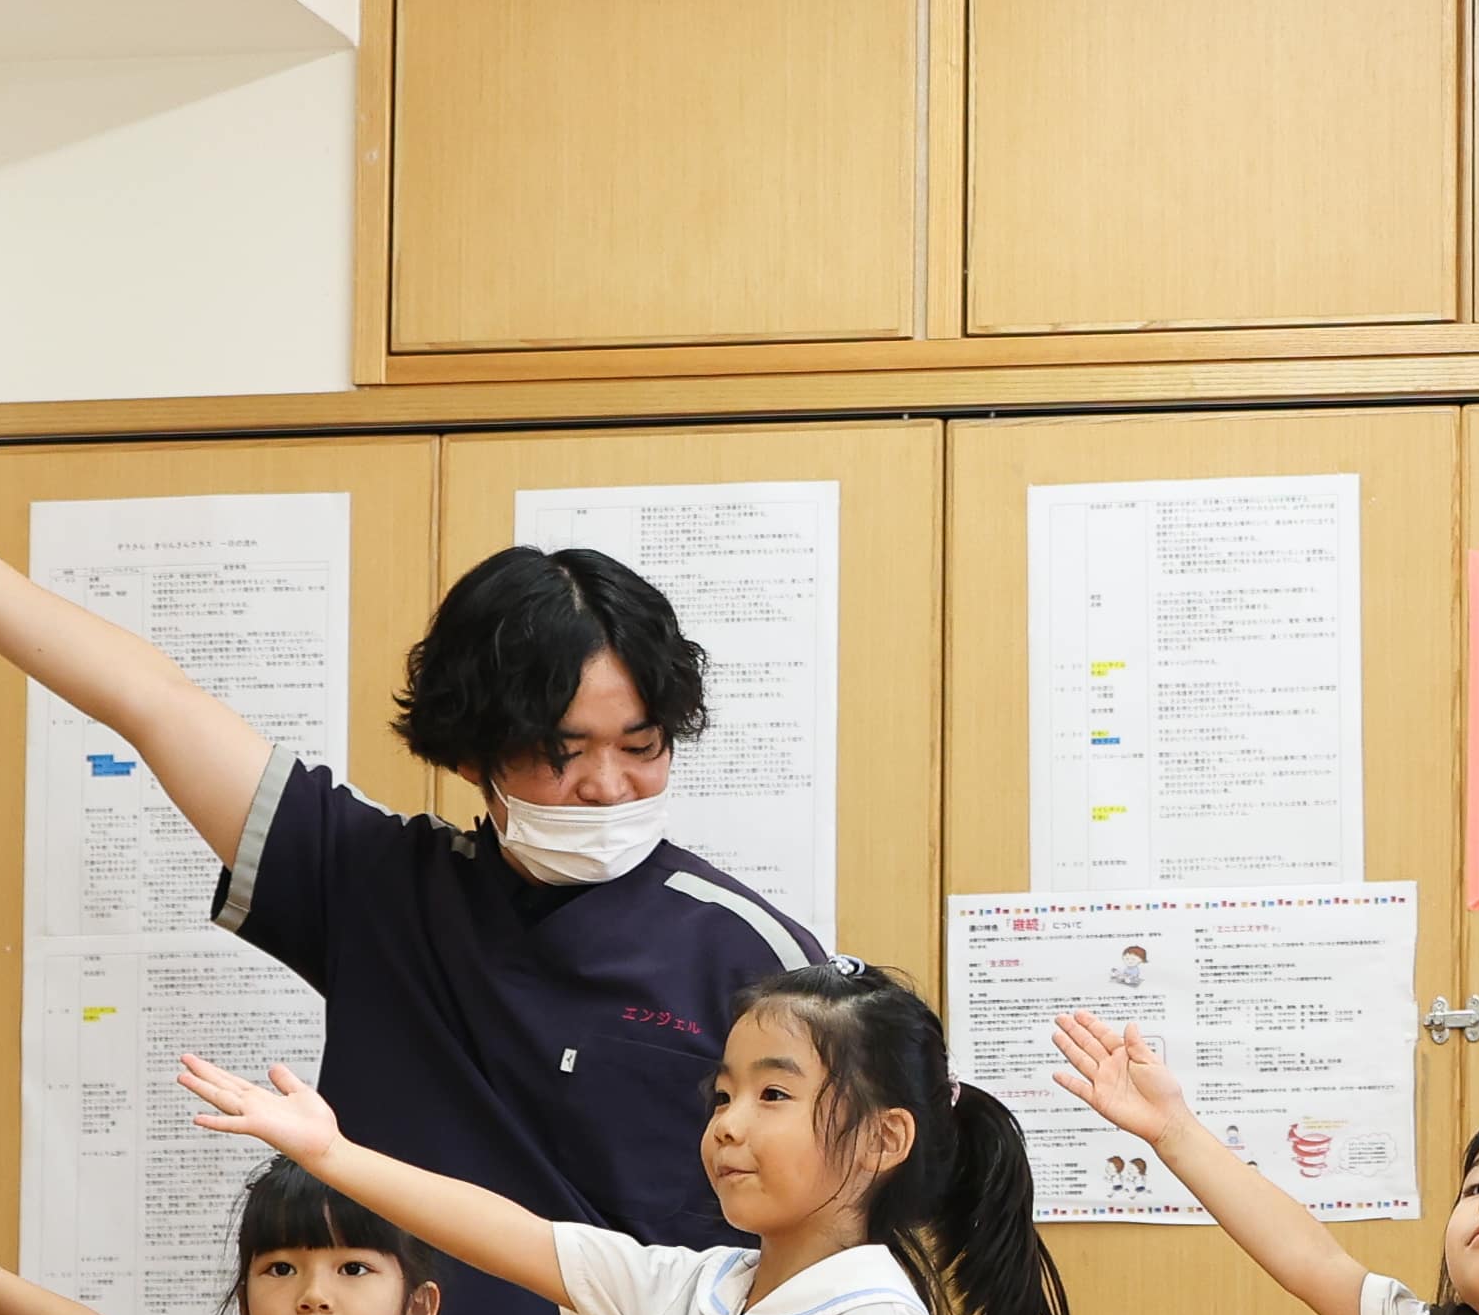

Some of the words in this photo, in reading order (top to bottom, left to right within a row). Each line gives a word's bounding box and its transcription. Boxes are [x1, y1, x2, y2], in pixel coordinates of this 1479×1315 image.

[622, 1006, 703, 1035] エンジェル
